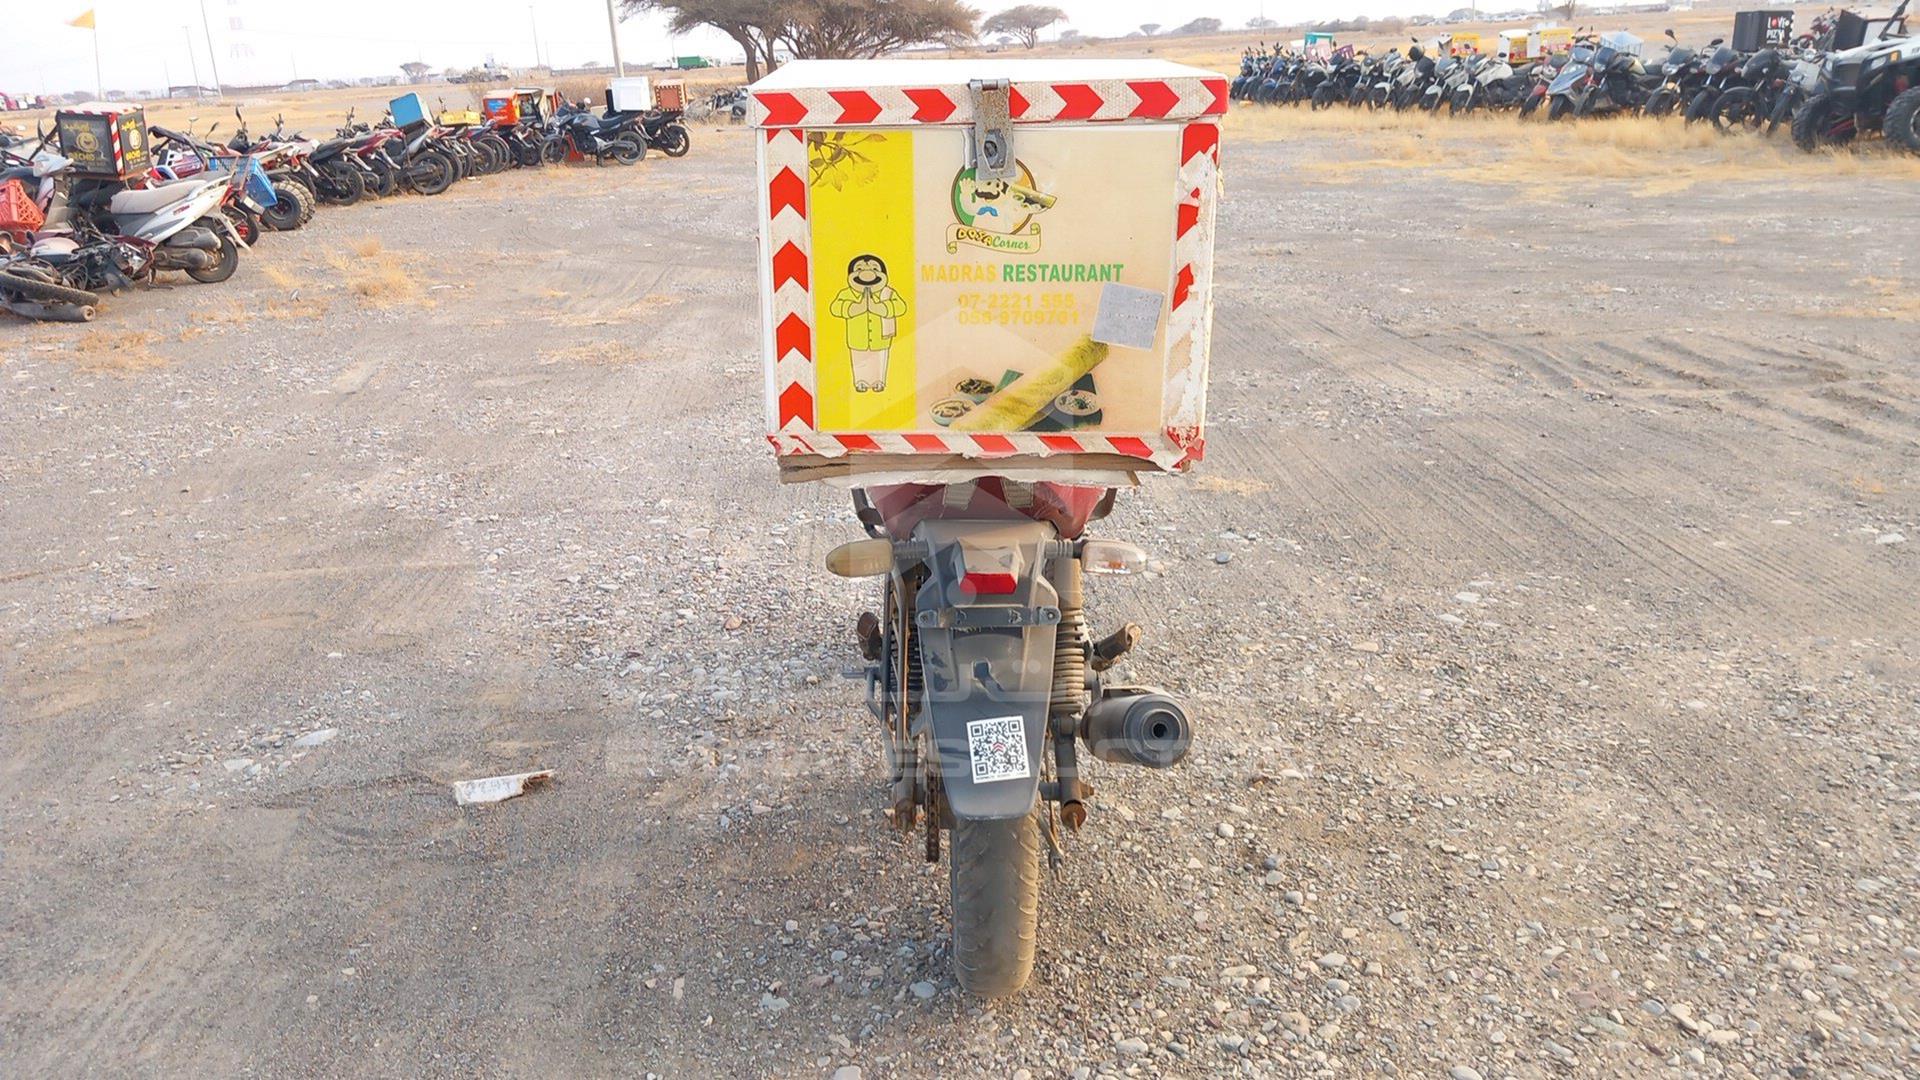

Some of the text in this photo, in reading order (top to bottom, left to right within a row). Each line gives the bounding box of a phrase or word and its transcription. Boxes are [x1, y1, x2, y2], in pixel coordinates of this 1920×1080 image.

[956, 228, 1029, 250] DOSA Corner
[920, 263, 1124, 283] MADRAS RESTAURANT
